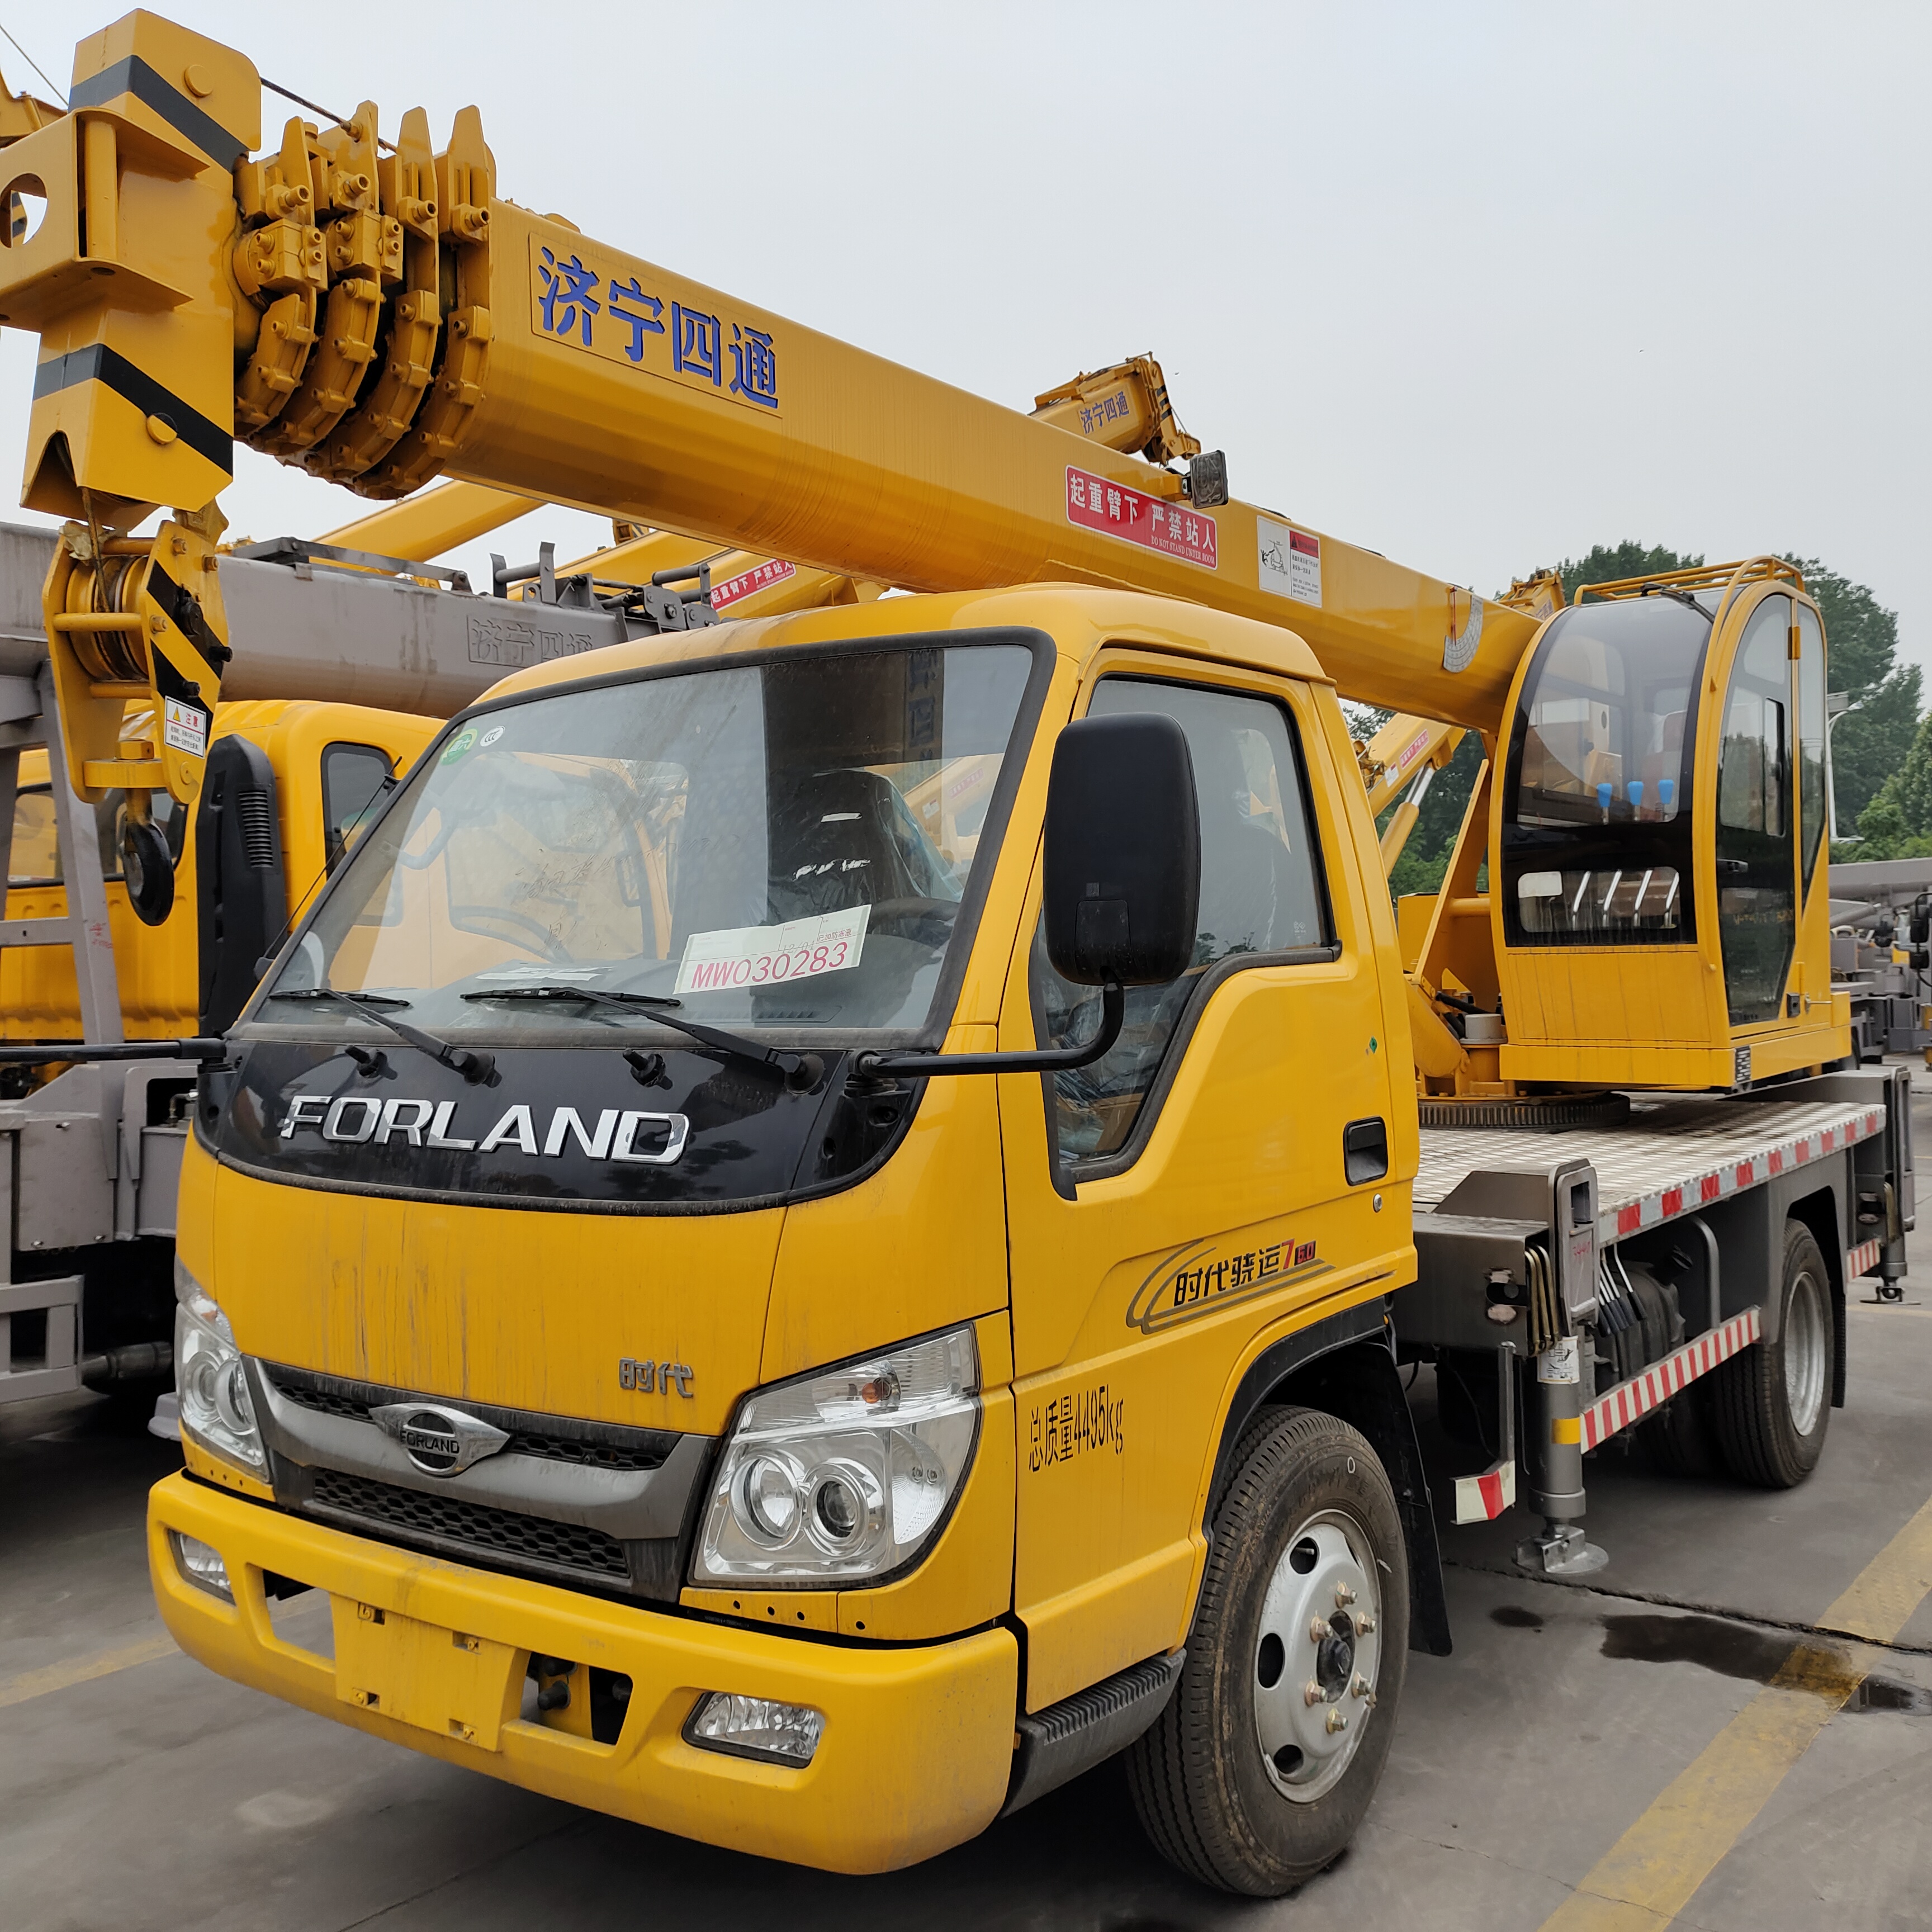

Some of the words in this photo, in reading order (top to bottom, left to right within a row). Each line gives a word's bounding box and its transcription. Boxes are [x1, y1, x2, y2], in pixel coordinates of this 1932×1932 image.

[538, 245, 779, 409] 济宁四通
[1080, 391, 1129, 434] 济宁四通
[1070, 474, 1138, 525] 起重臂下
[1152, 504, 1214, 552] 严禁站人
[1152, 535, 1159, 546] DO
[1159, 538, 1169, 550] NOT
[1169, 542, 1185, 554] STAND
[1186, 547, 1201, 560] UNDER
[280, 1095, 690, 1165] FORLAND
[619, 1357, 694, 1398] 时代
[400, 1430, 460, 1454] FORLAND
